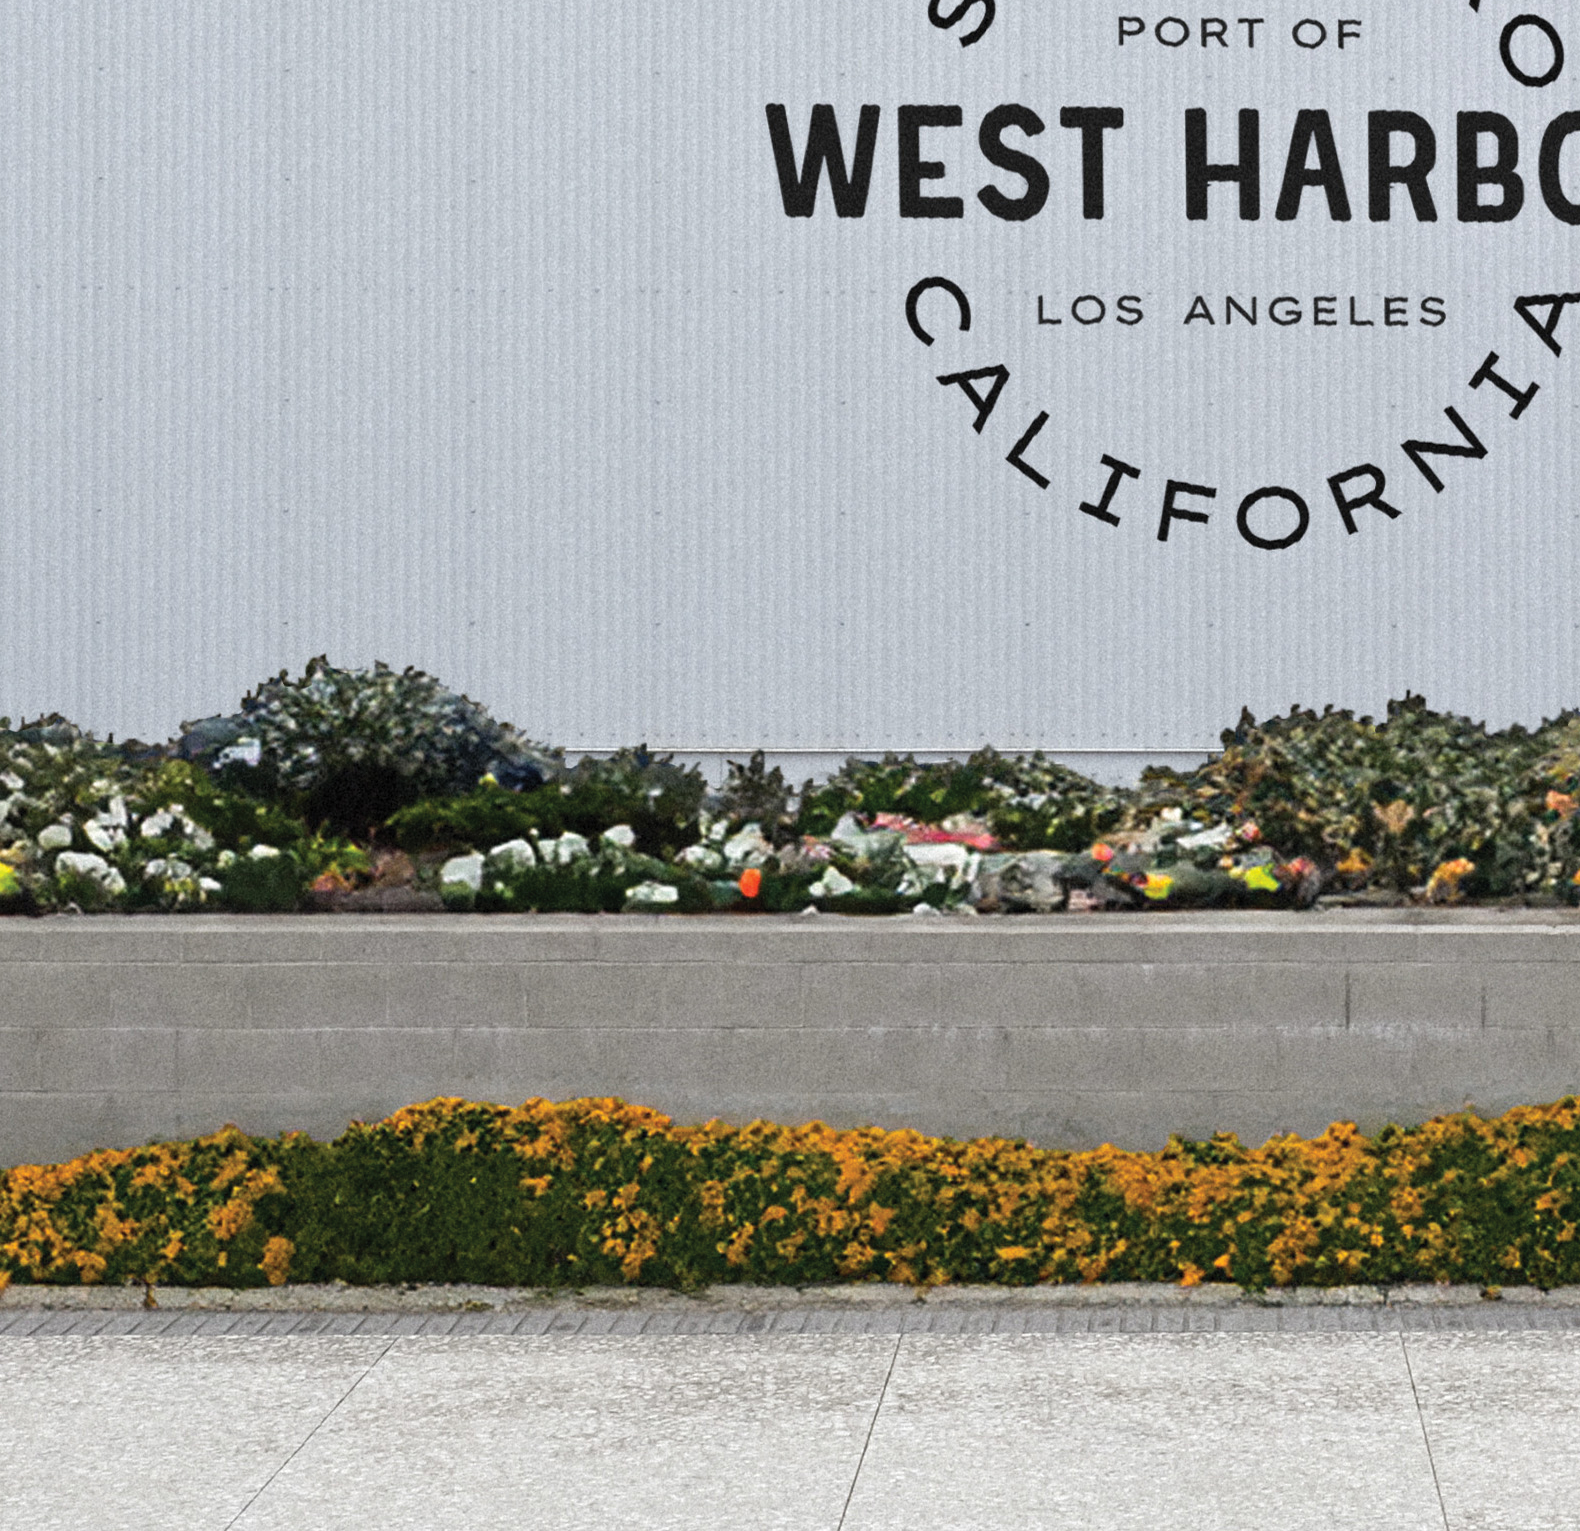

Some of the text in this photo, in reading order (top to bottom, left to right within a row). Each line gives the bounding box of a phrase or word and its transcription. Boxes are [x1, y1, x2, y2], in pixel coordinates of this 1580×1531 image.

[1116, 15, 1363, 50] PORT OF
[764, 102, 1125, 222] WEST
[1035, 294, 1449, 328] LOS ANGELES
